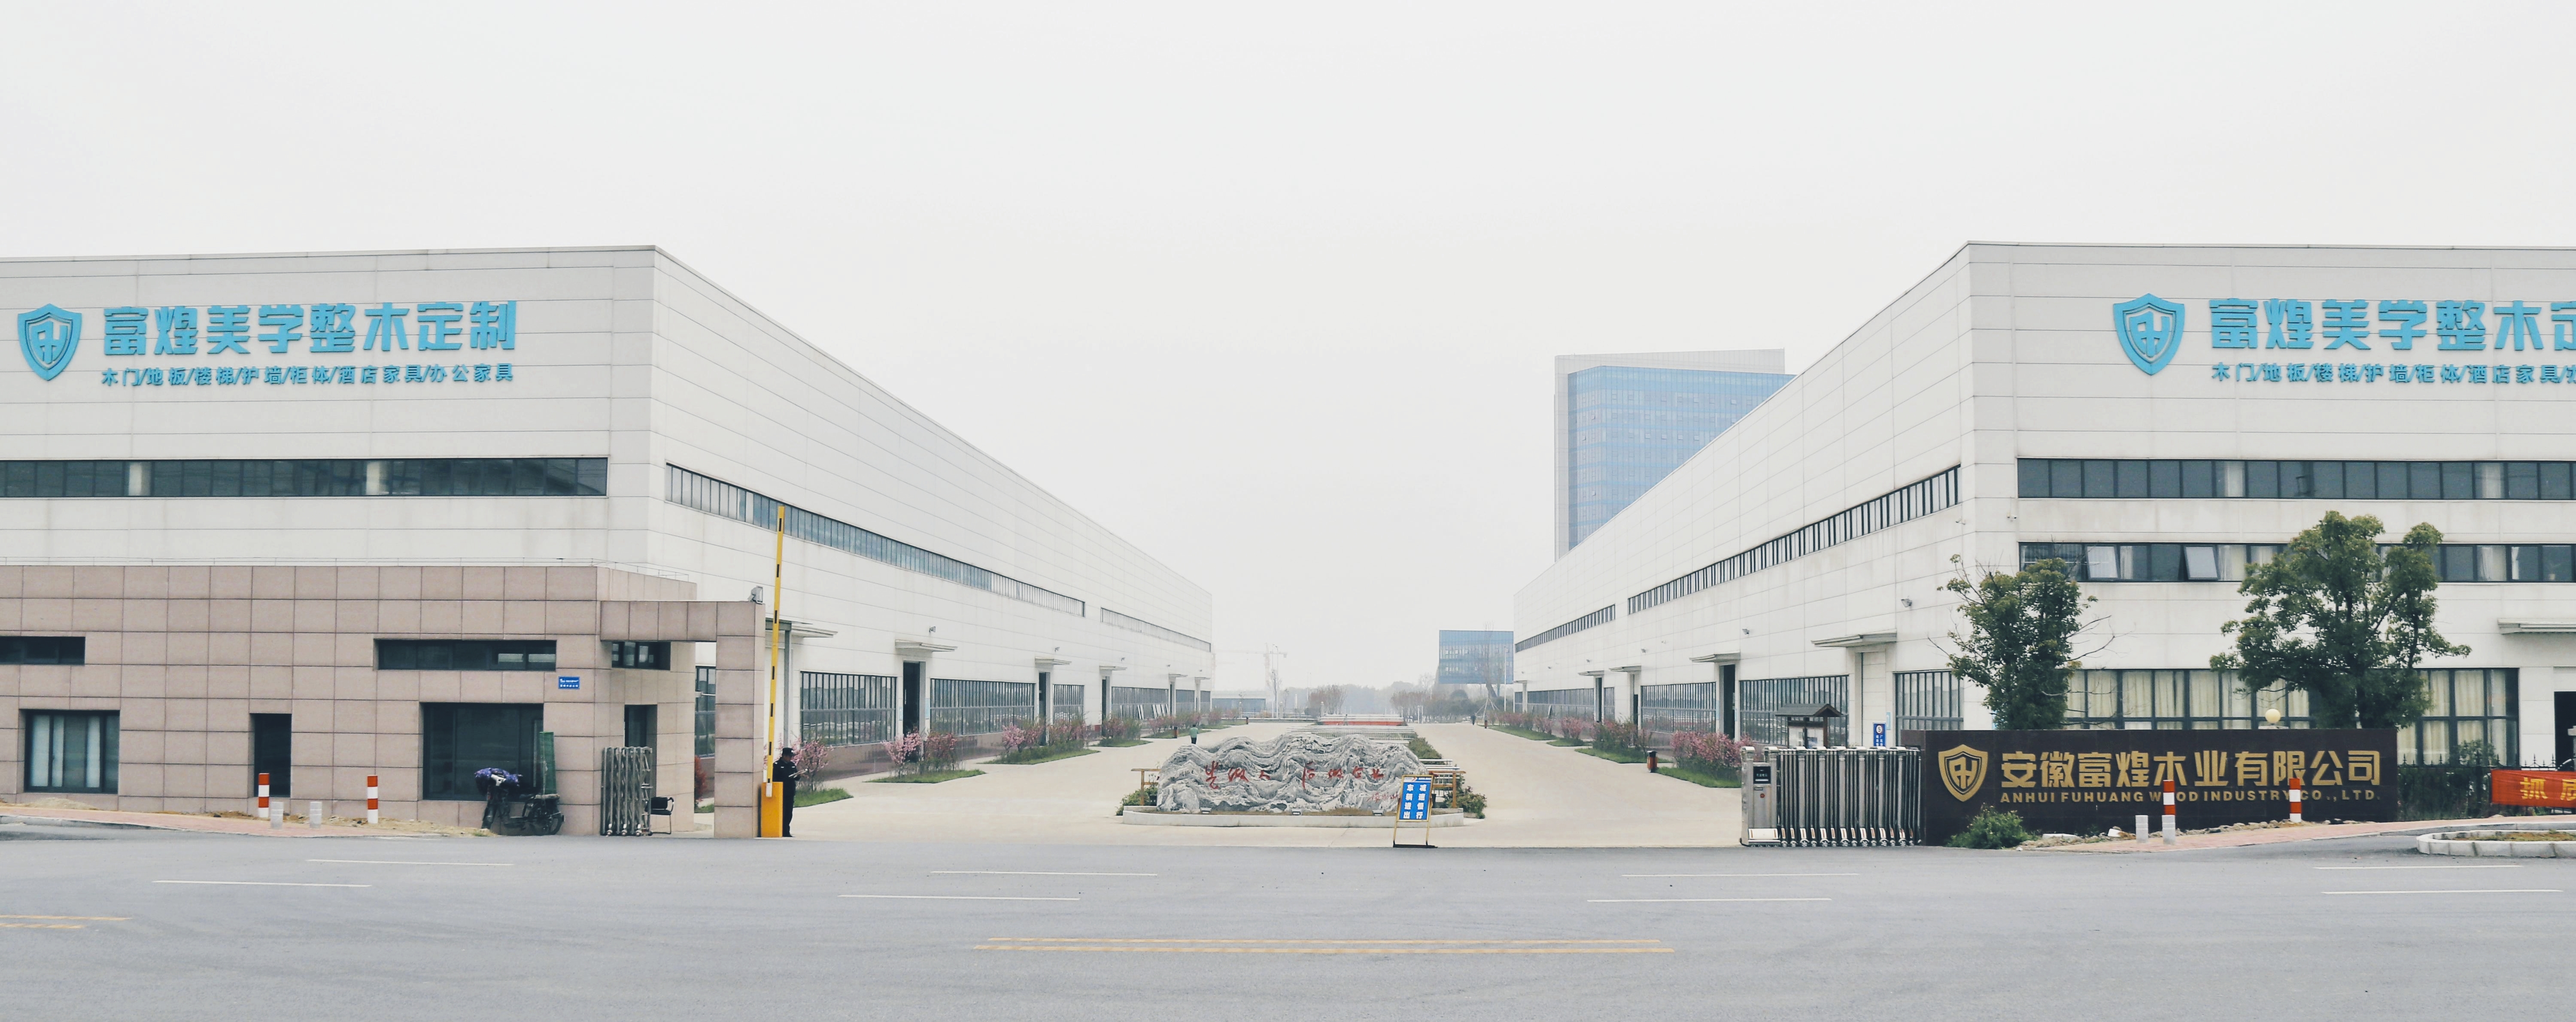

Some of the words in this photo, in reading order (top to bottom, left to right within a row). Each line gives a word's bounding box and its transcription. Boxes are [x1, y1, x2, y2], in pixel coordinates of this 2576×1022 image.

[103, 300, 516, 355] 富煌美学整木定制
[101, 363, 513, 386] 木门/地板/楼梯/护墙/柜体/酒店家具/办公家具
[2001, 750, 2380, 788] 安徽富煌木业有限公司
[2000, 792, 2055, 803] ANHUI
[2061, 792, 2144, 802] FUHUANG
[2149, 791, 2198, 802] WOD
